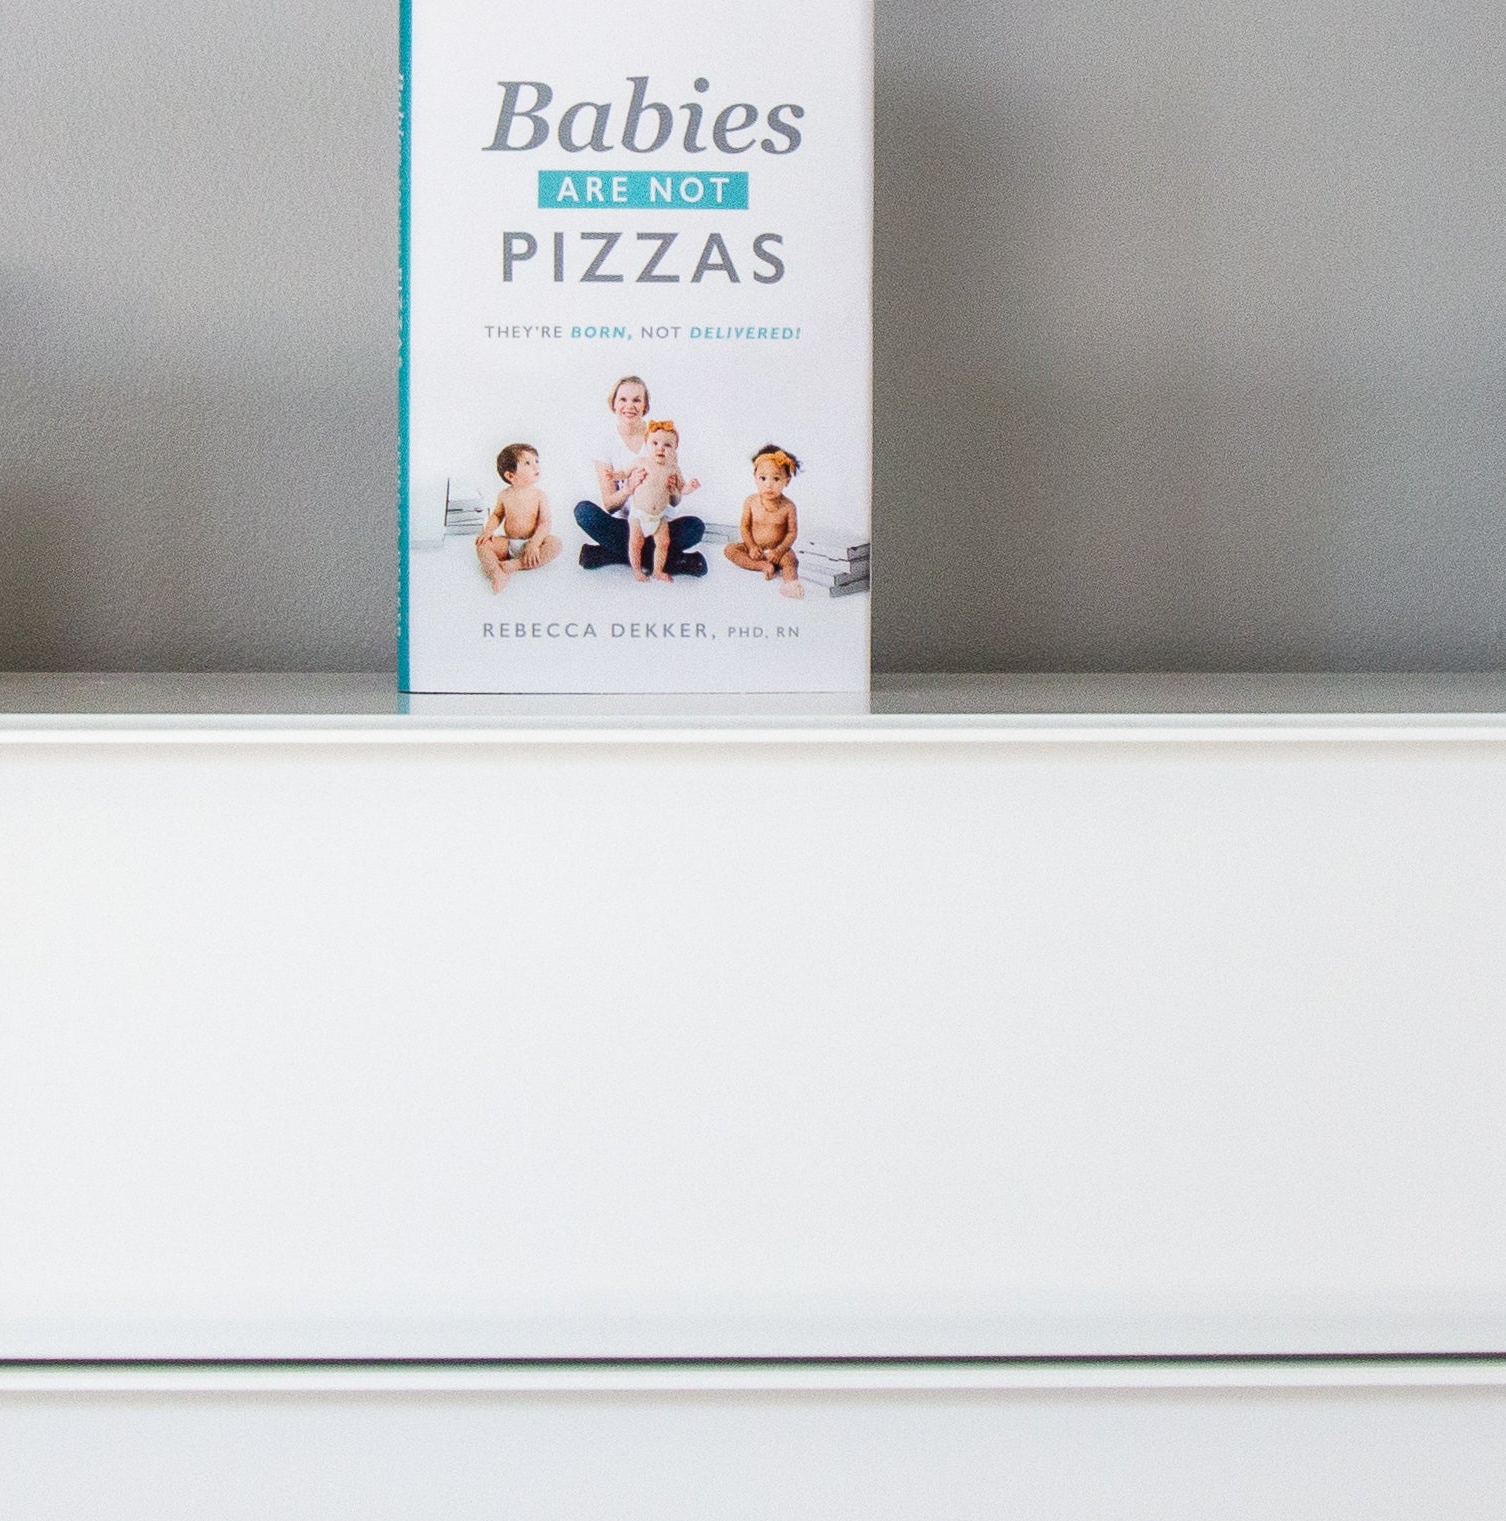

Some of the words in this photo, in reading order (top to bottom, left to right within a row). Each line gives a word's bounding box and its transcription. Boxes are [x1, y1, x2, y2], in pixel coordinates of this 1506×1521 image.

[481, 75, 806, 156] Babies
[556, 176, 628, 203] ARE
[649, 176, 731, 204] NOT
[502, 231, 786, 285] PIZZAS
[484, 325, 562, 339] THEY'RE
[570, 325, 633, 340] BORN,
[640, 326, 681, 339] NOT
[689, 326, 802, 340] DELIVERED!
[483, 622, 598, 638] REBECCA
[611, 622, 716, 640] DEKKER,
[776, 626, 800, 638] RN
